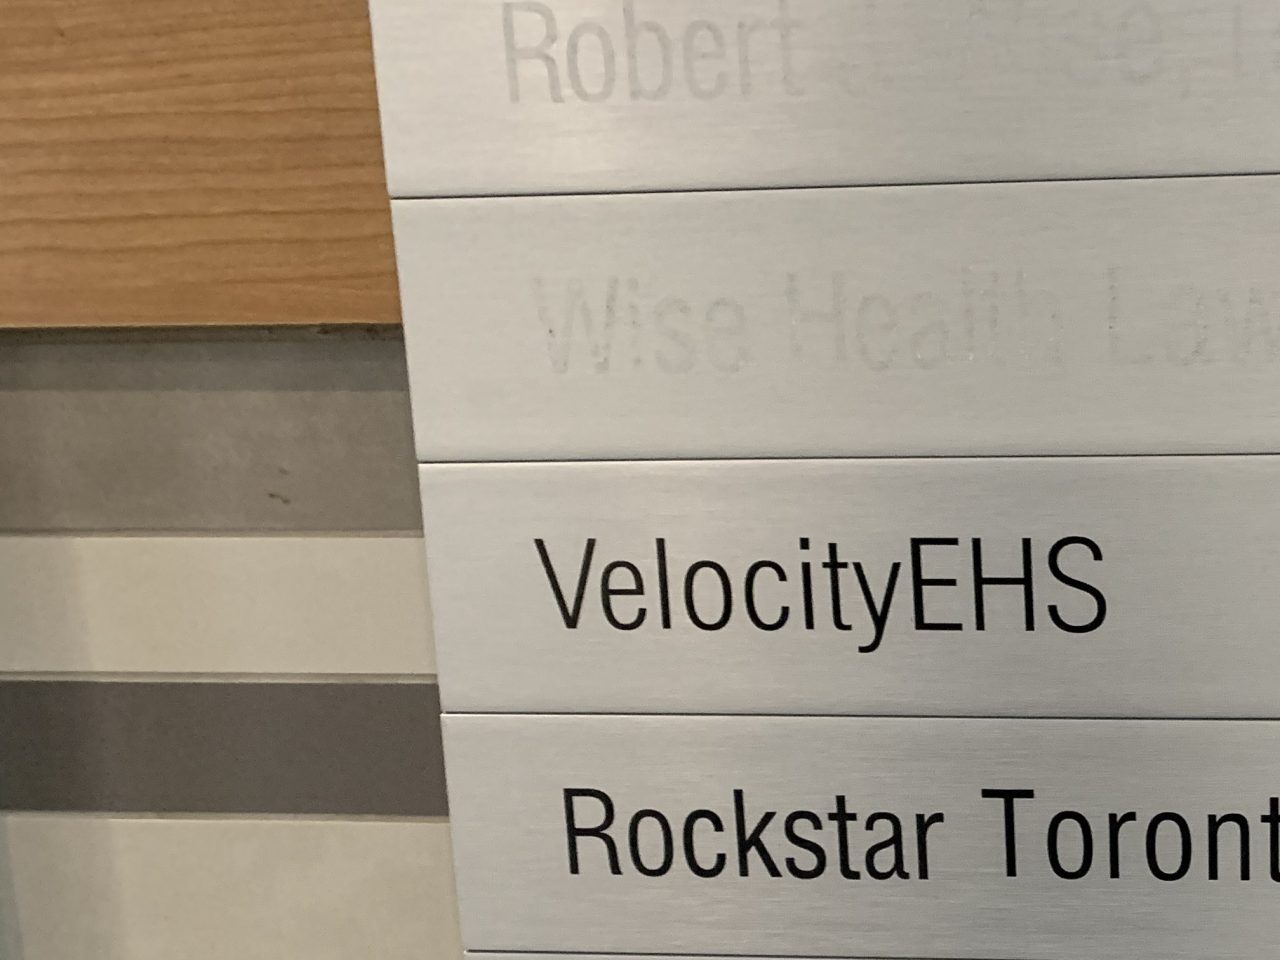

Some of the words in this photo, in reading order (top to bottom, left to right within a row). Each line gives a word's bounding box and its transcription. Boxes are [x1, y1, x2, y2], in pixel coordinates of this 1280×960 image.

[503, 0, 807, 104] Robert
[534, 535, 1107, 654] VelocityEHS
[563, 787, 945, 881] Rockstar
